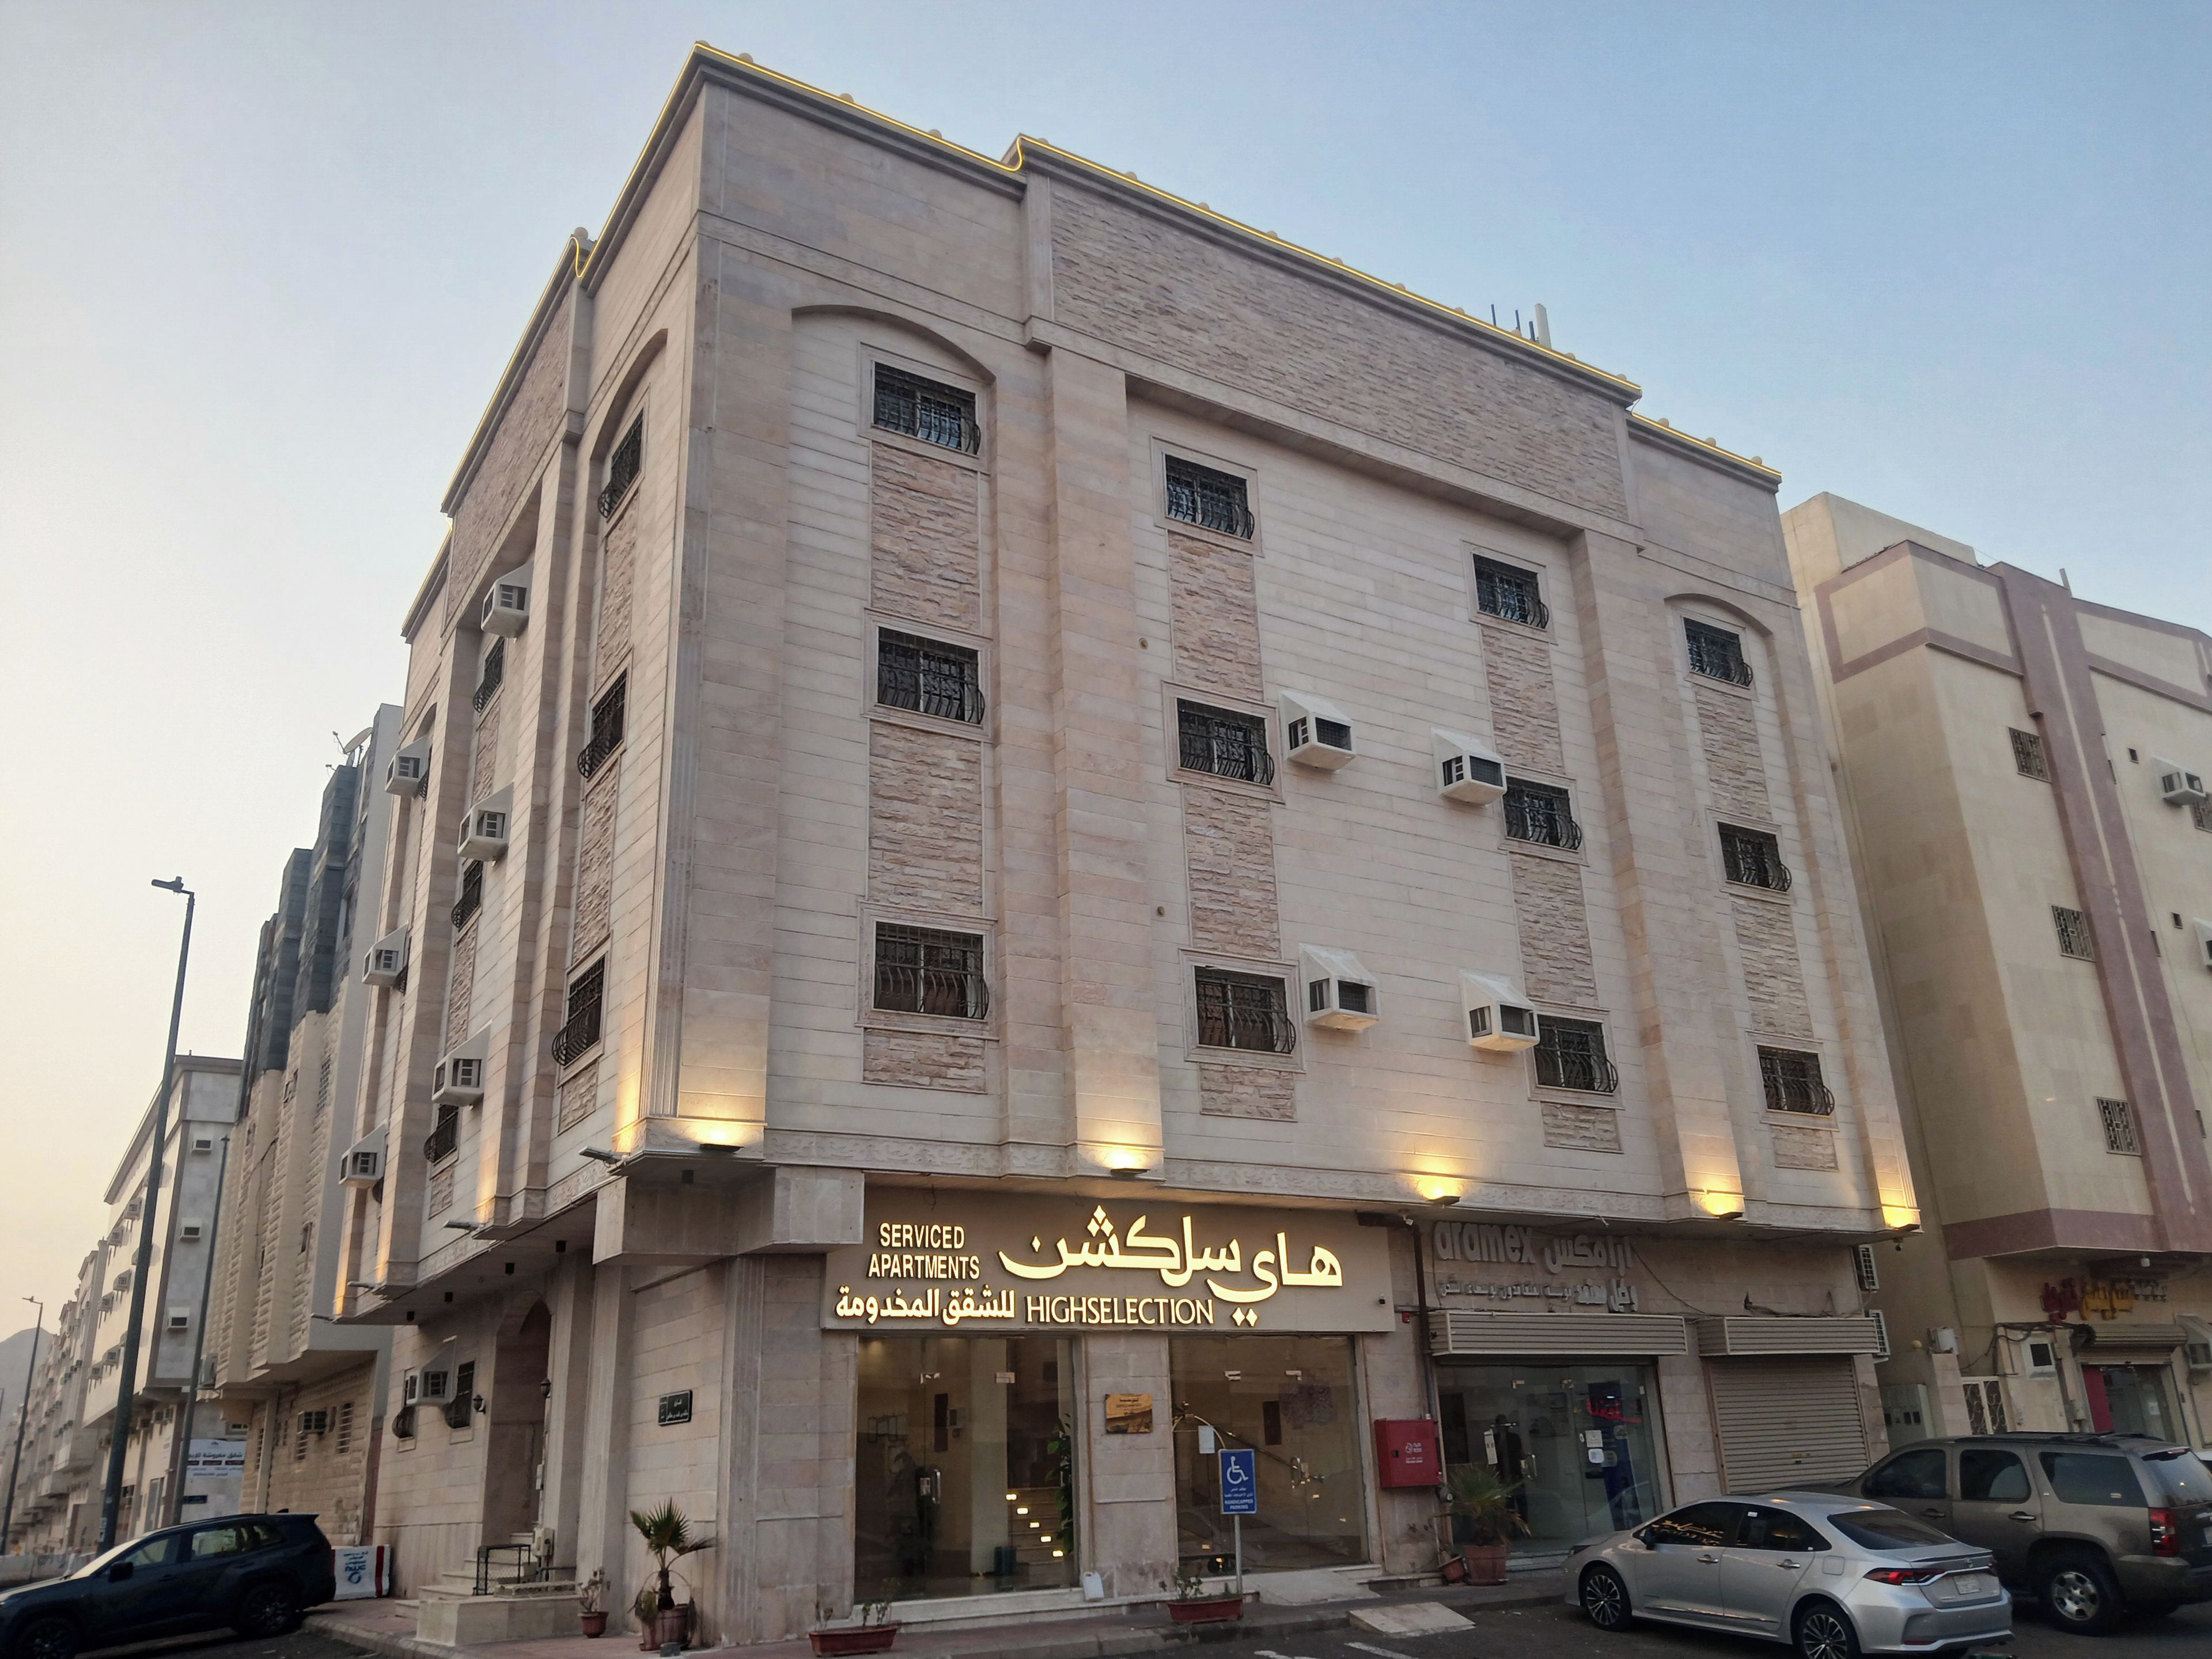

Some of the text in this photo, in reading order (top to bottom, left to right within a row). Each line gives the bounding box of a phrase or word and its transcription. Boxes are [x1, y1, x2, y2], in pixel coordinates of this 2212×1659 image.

[879, 1222, 965, 1249] SERVICED
[1434, 1221, 1536, 1264] aramex
[868, 1252, 980, 1279] APARTMENTS
[997, 1205, 1343, 1327] هاي سلكشن
[835, 1284, 1015, 1325] للشقق المخدومة
[1026, 1295, 1214, 1324] HIGHSELECTION
